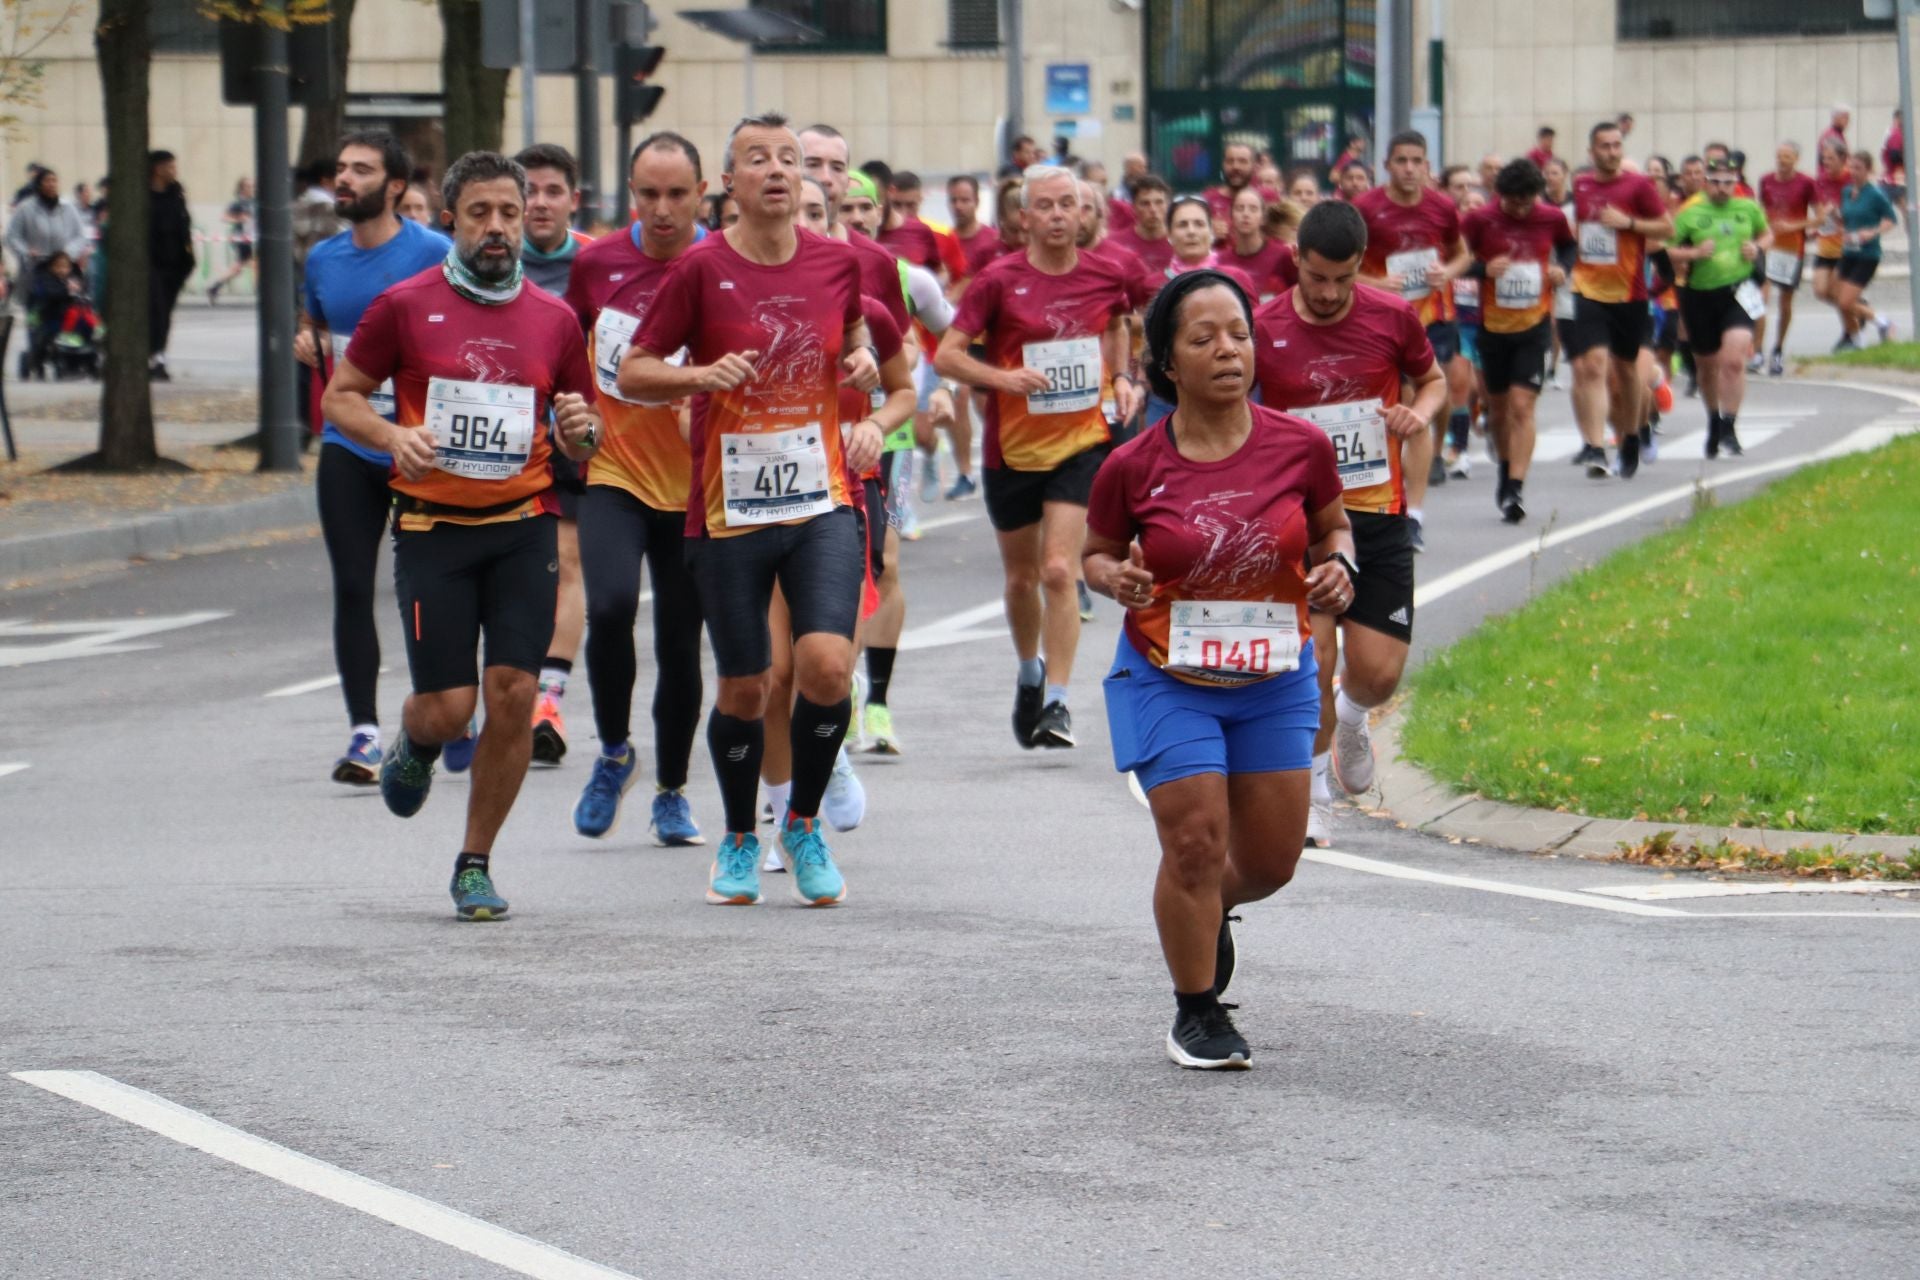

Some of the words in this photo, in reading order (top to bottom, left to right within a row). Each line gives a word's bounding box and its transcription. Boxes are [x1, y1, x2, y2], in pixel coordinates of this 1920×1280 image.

[1044, 364, 1086, 393] 390
[449, 413, 508, 453] 964
[1331, 431, 1366, 465] 64
[462, 461, 511, 473] HYUNDAI
[754, 462, 800, 497] 412
[765, 503, 814, 516] HYUNDAI
[1201, 638, 1270, 673] 040
